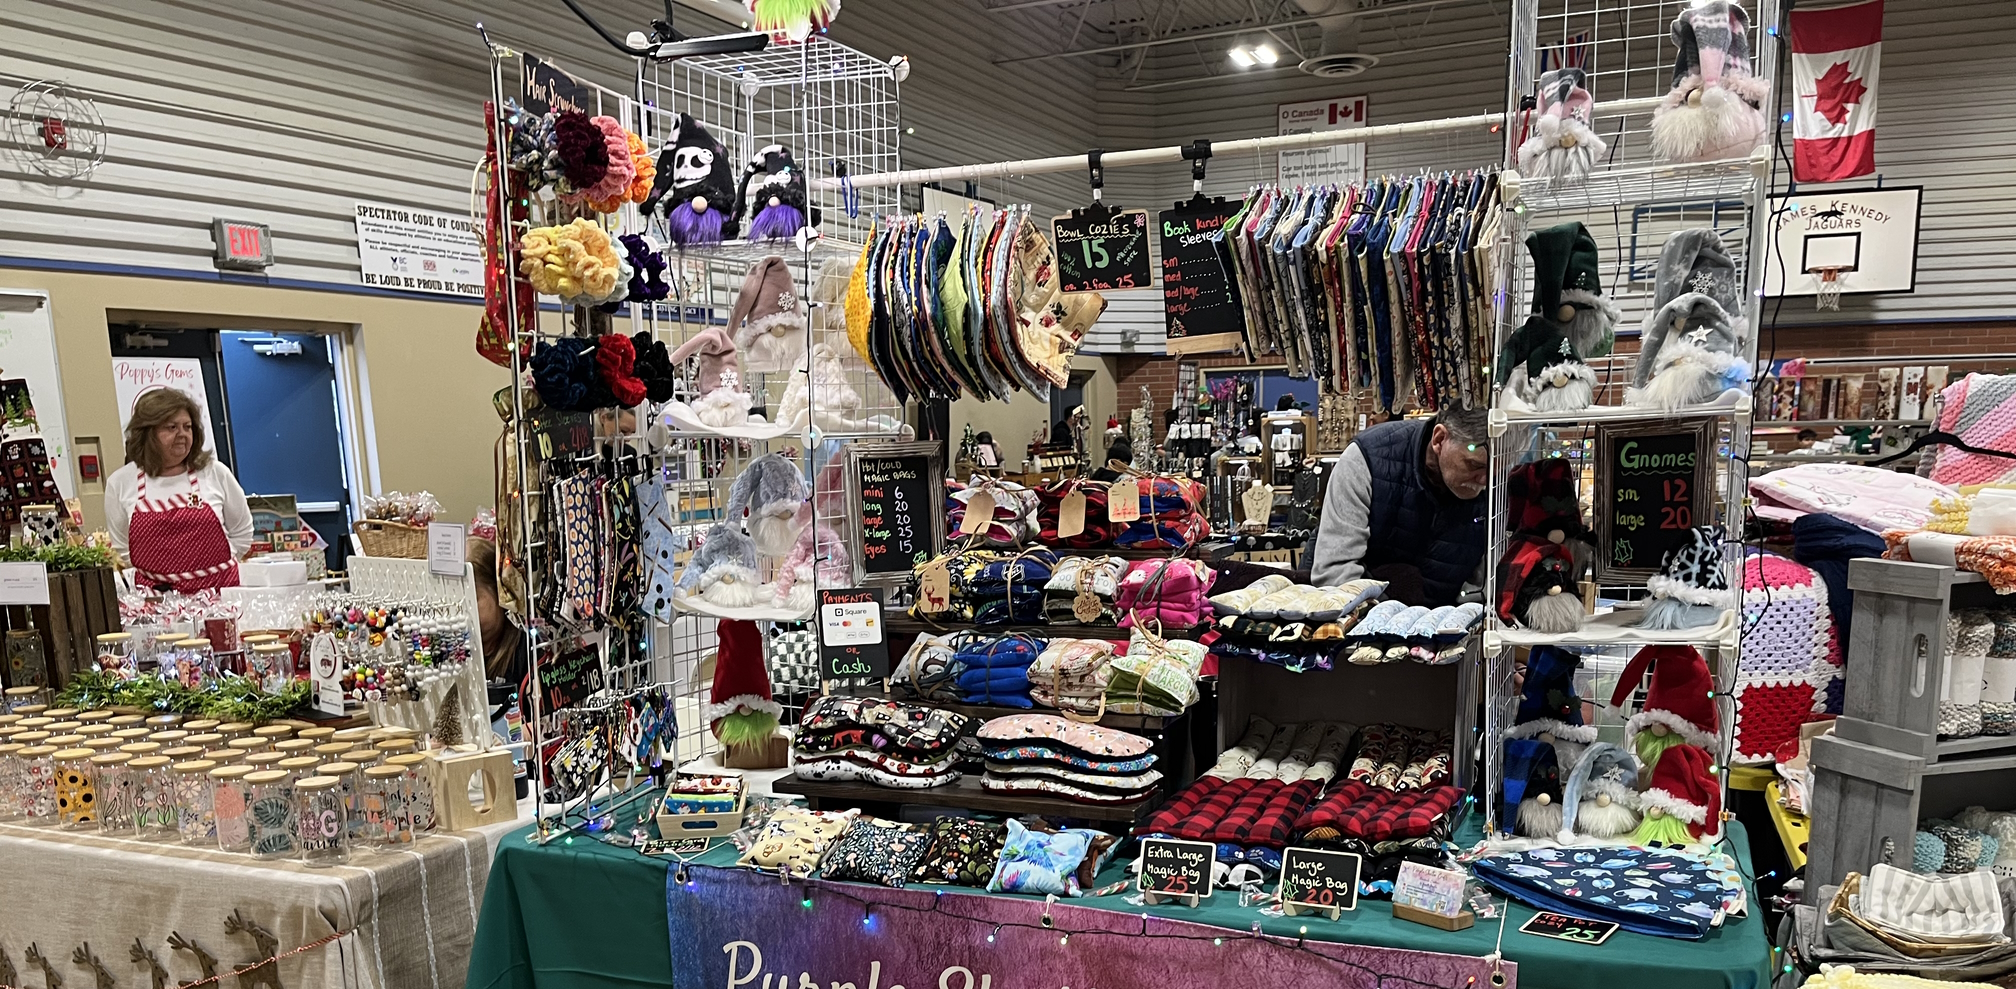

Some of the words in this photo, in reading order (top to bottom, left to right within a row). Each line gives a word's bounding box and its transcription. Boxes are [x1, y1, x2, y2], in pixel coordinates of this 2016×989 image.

[1282, 111, 1289, 119] O
[1292, 108, 1324, 118] Canada
[357, 205, 410, 223] SPECTATOR
[412, 213, 434, 226] CODE
[437, 217, 448, 228] OF
[1830, 200, 1890, 224] KENNEDY
[1089, 224, 1130, 235] COZIES
[1164, 221, 1192, 238] Book
[1805, 216, 1861, 230] JAGUARS
[228, 225, 260, 258] EXIT
[1082, 238, 1110, 269] 15
[1163, 257, 1178, 268] sm
[365, 273, 376, 284] BE
[404, 277, 415, 288] BE
[445, 282, 454, 292] BE
[457, 283, 485, 295] POSITIV
[1082, 281, 1092, 290] 2
[1116, 274, 1135, 288] 25
[1164, 271, 1182, 282] med
[1166, 303, 1191, 316] large
[115, 362, 161, 385] Poppy's
[165, 363, 194, 384] Gems
[538, 432, 553, 460] 10
[1620, 441, 1696, 469] Gnomes
[864, 474, 890, 483] MAGIC
[892, 470, 917, 480] BAGS
[864, 485, 884, 498] mini
[894, 486, 904, 500] 6
[1618, 488, 1640, 502] sm
[1664, 478, 1688, 502] 12
[862, 500, 883, 515] long
[894, 500, 909, 512] 20
[863, 515, 884, 528] large
[896, 514, 911, 525] 20
[1616, 510, 1645, 531] large
[1660, 506, 1692, 530] 20
[898, 525, 913, 538] 25
[864, 542, 887, 559] Eyes
[900, 540, 913, 554] 15
[822, 591, 873, 605] PAYMENTS
[832, 657, 872, 675] Cash
[551, 686, 562, 710] 10
[1148, 846, 1173, 858] Extra
[1176, 848, 1205, 867] Large
[1148, 863, 1178, 878] Magic
[1181, 866, 1200, 884] Bag
[1293, 856, 1325, 876] Large
[1163, 876, 1188, 894] 25
[1292, 874, 1322, 889] Magic
[1325, 877, 1348, 896] Bag
[1303, 888, 1333, 906] 20
[1542, 914, 1567, 922] TEA
[1559, 927, 1601, 940] 25
